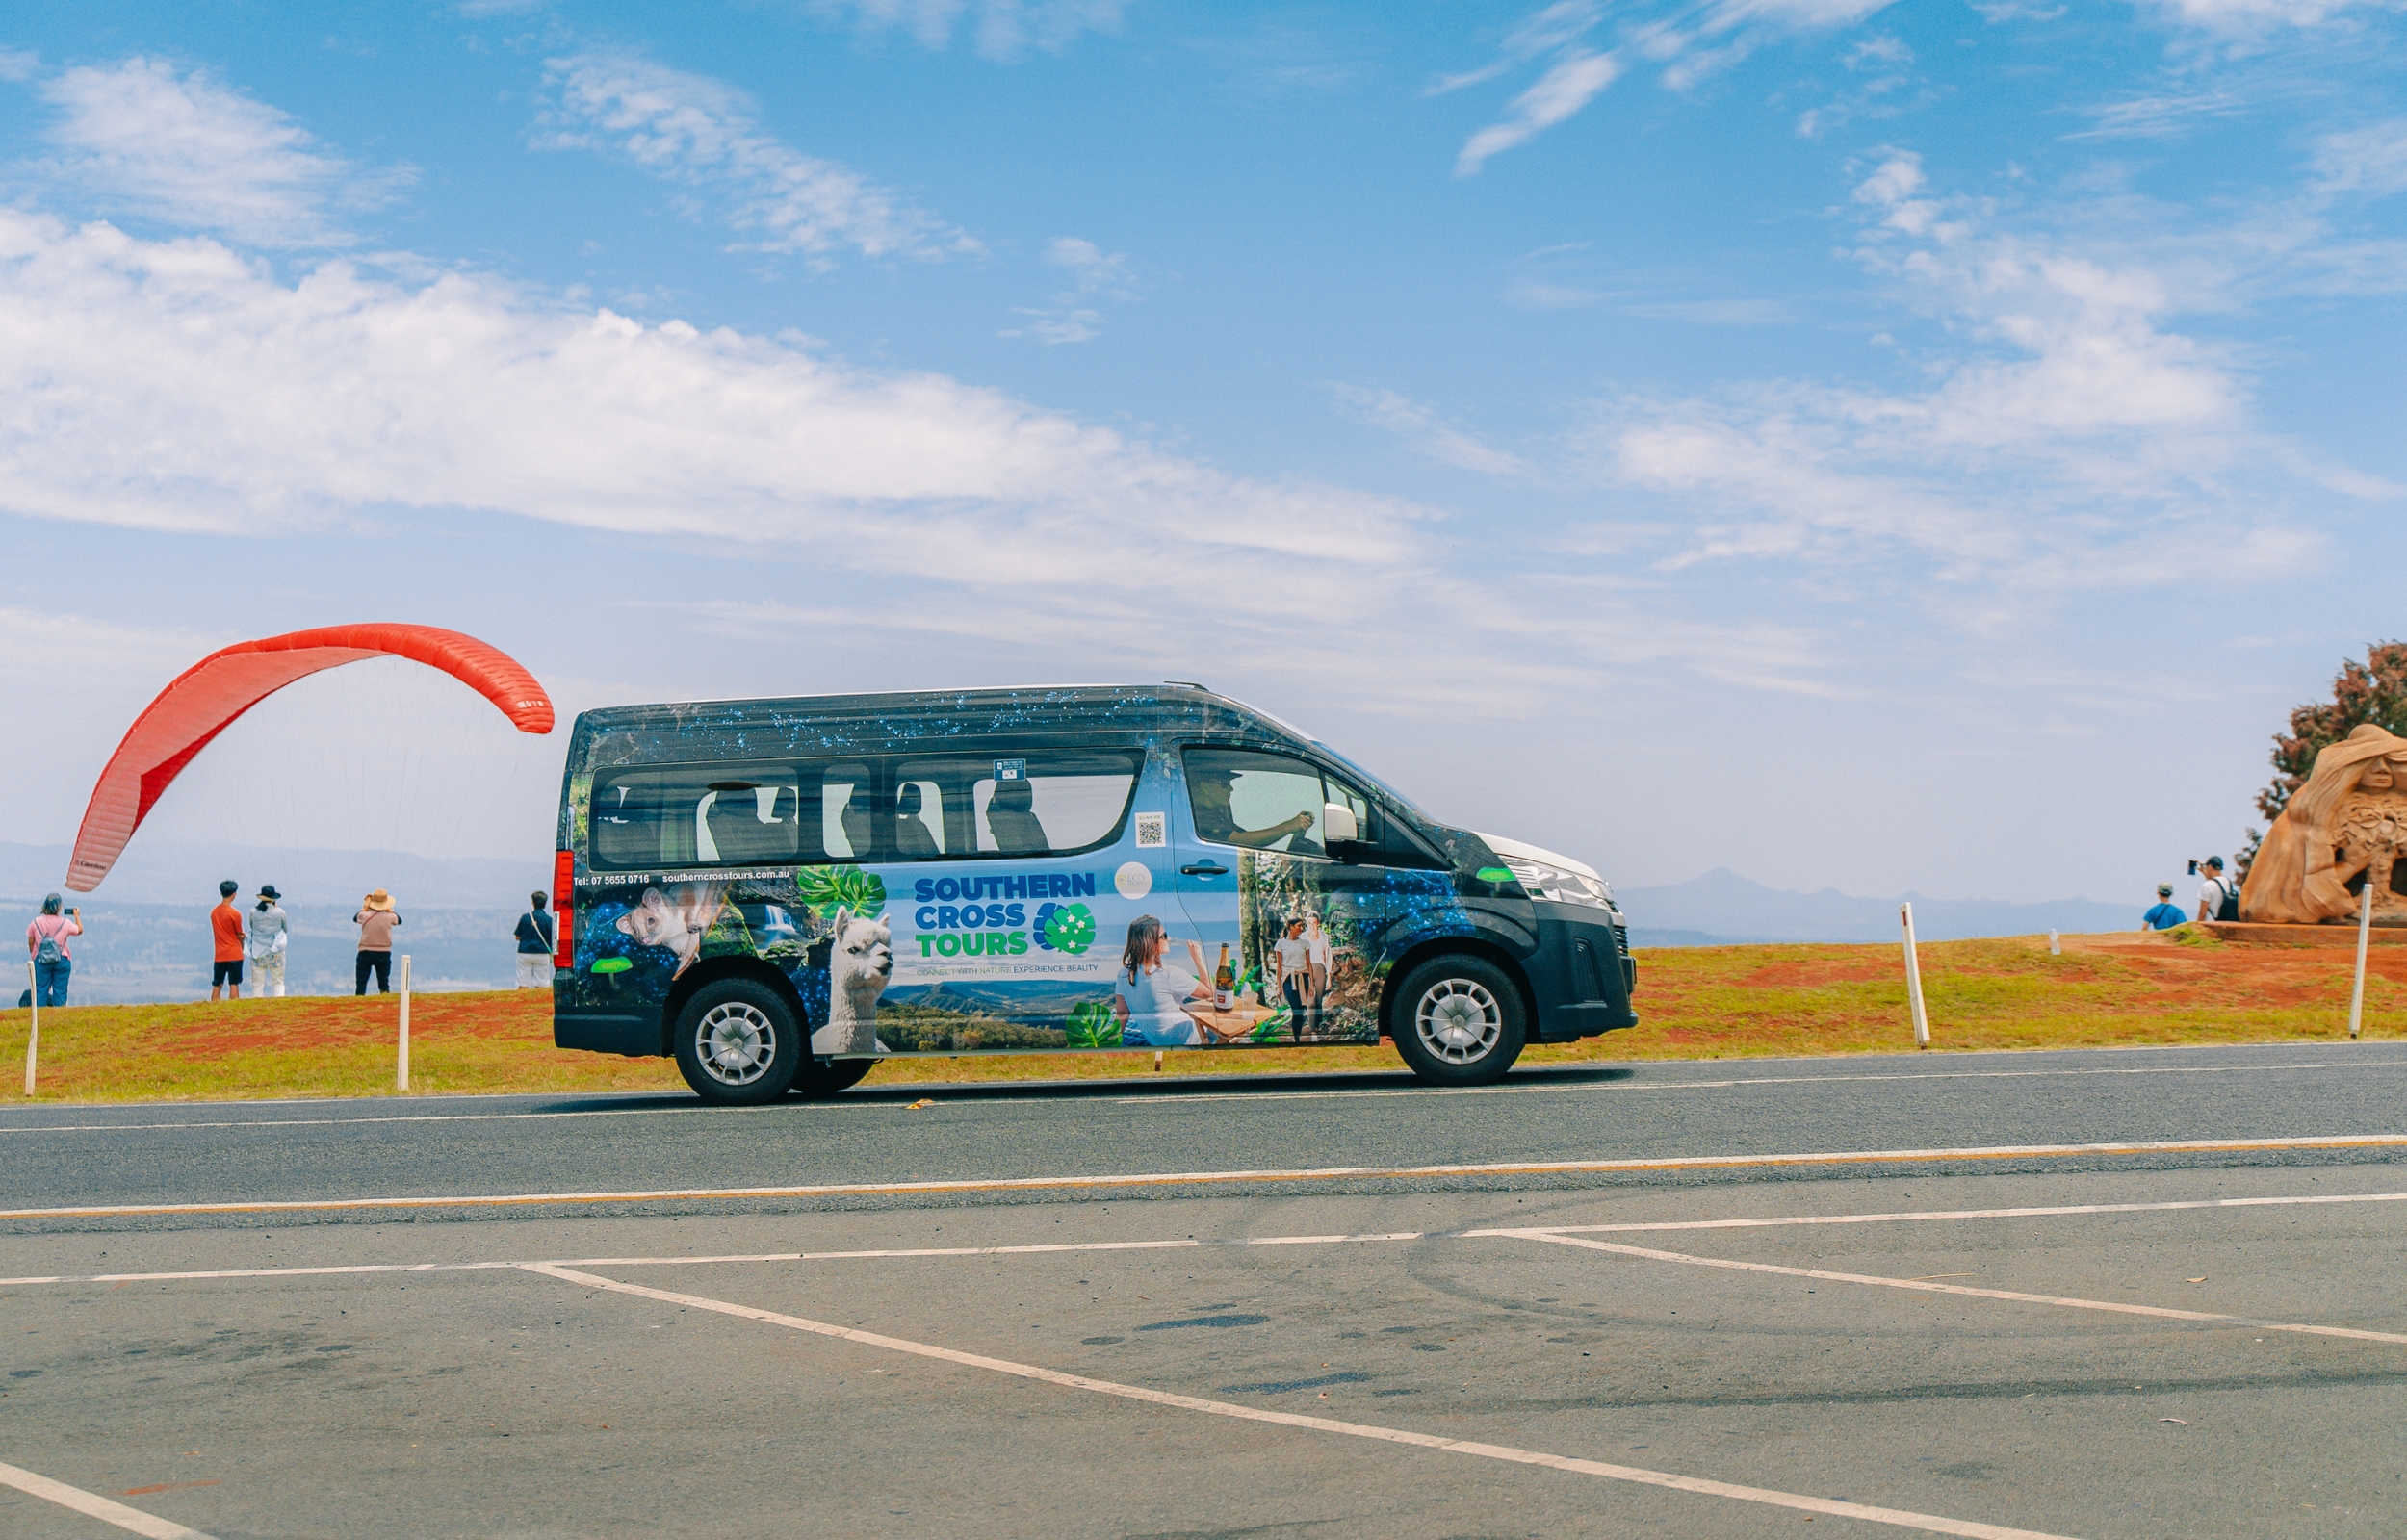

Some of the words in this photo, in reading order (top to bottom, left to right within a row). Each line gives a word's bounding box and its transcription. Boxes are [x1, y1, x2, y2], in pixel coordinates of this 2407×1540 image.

[574, 877, 589, 886] Tel:
[590, 876, 602, 885] 07
[604, 875, 626, 885] 5655
[627, 874, 650, 884] 0716
[662, 870, 789, 883] southerncrosstours.com.au
[915, 873, 1096, 902] SOUTHERN
[915, 903, 1026, 930] CROSS
[915, 931, 1028, 958] TOURS
[917, 967, 954, 976] CONNECT
[956, 966, 977, 975] WITH
[979, 966, 1011, 975] NATURE
